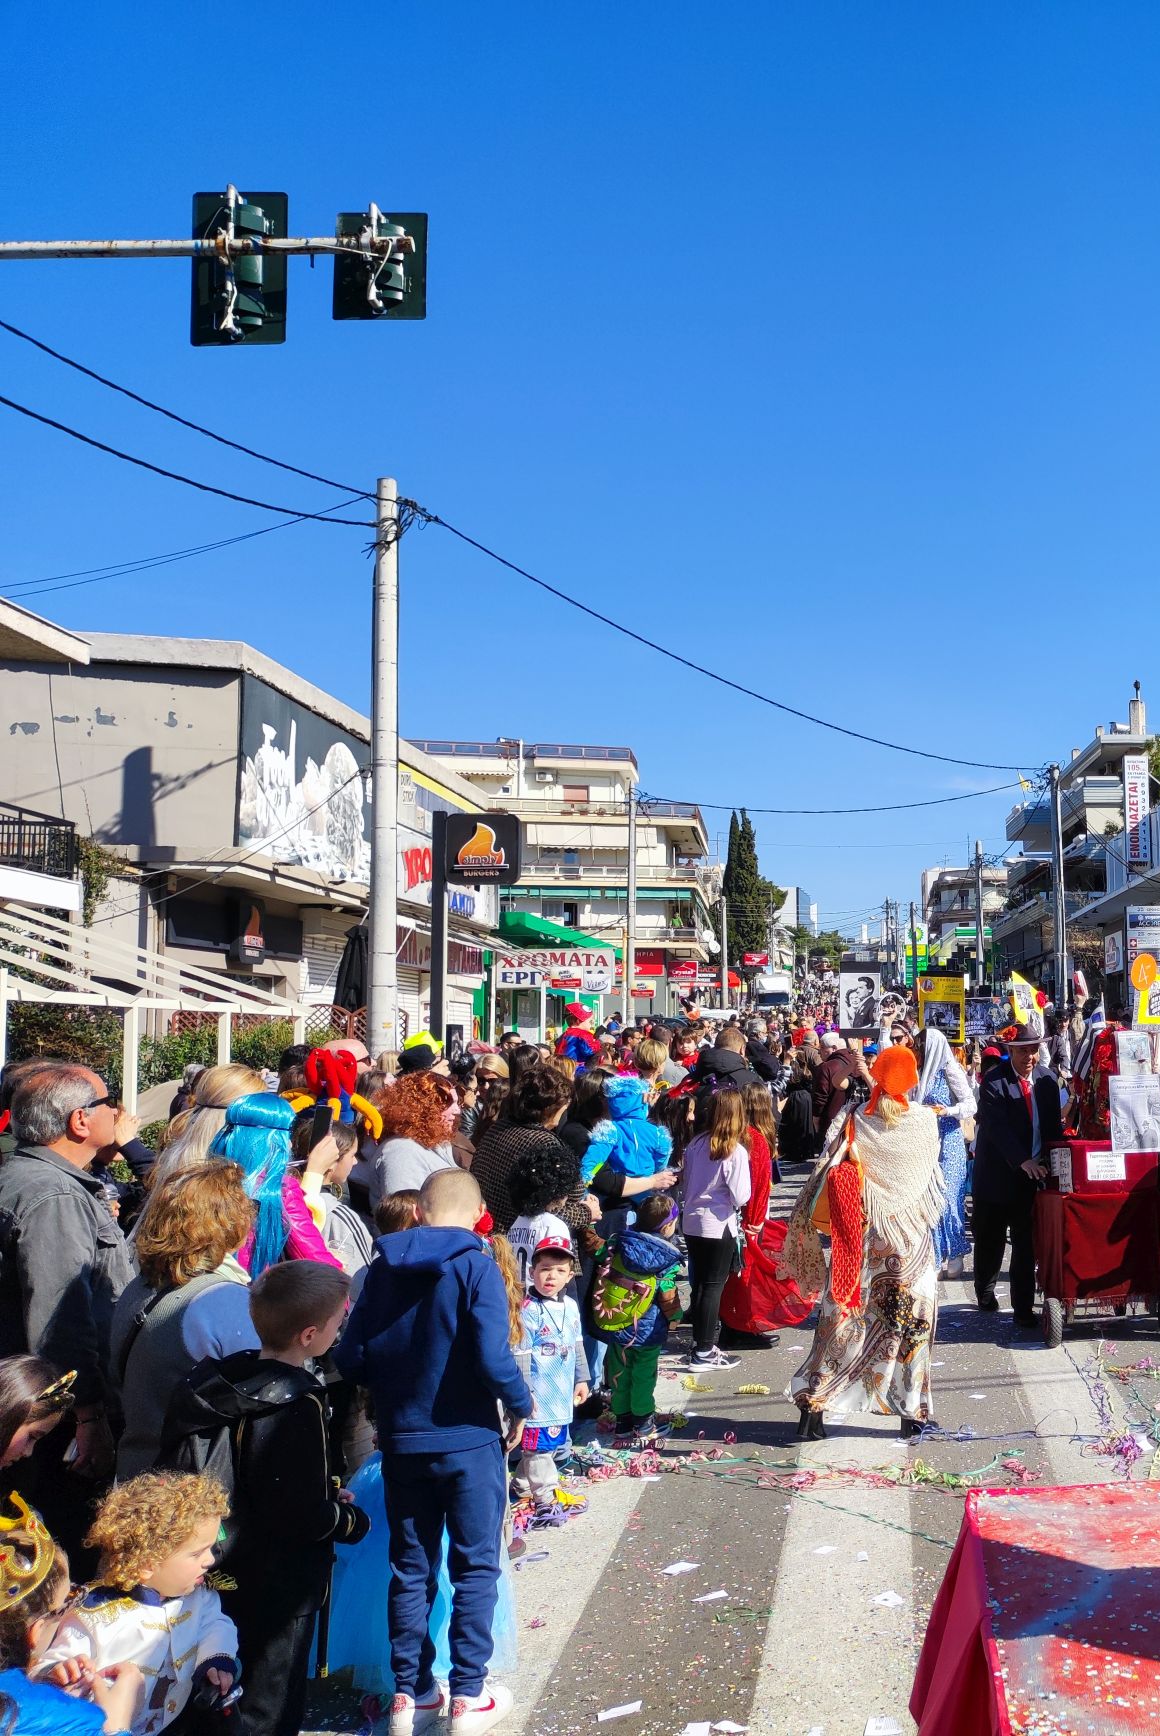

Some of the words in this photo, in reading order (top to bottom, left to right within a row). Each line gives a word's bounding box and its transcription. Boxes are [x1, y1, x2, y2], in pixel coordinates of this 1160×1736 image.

[1128, 782, 1140, 859] ΕΝΟΙΚΙΑΖΕΤΑΙ
[463, 854, 498, 867] simply
[463, 869, 500, 877] BURGERS
[501, 952, 609, 969] ΧΡΩΜΑΤΑ
